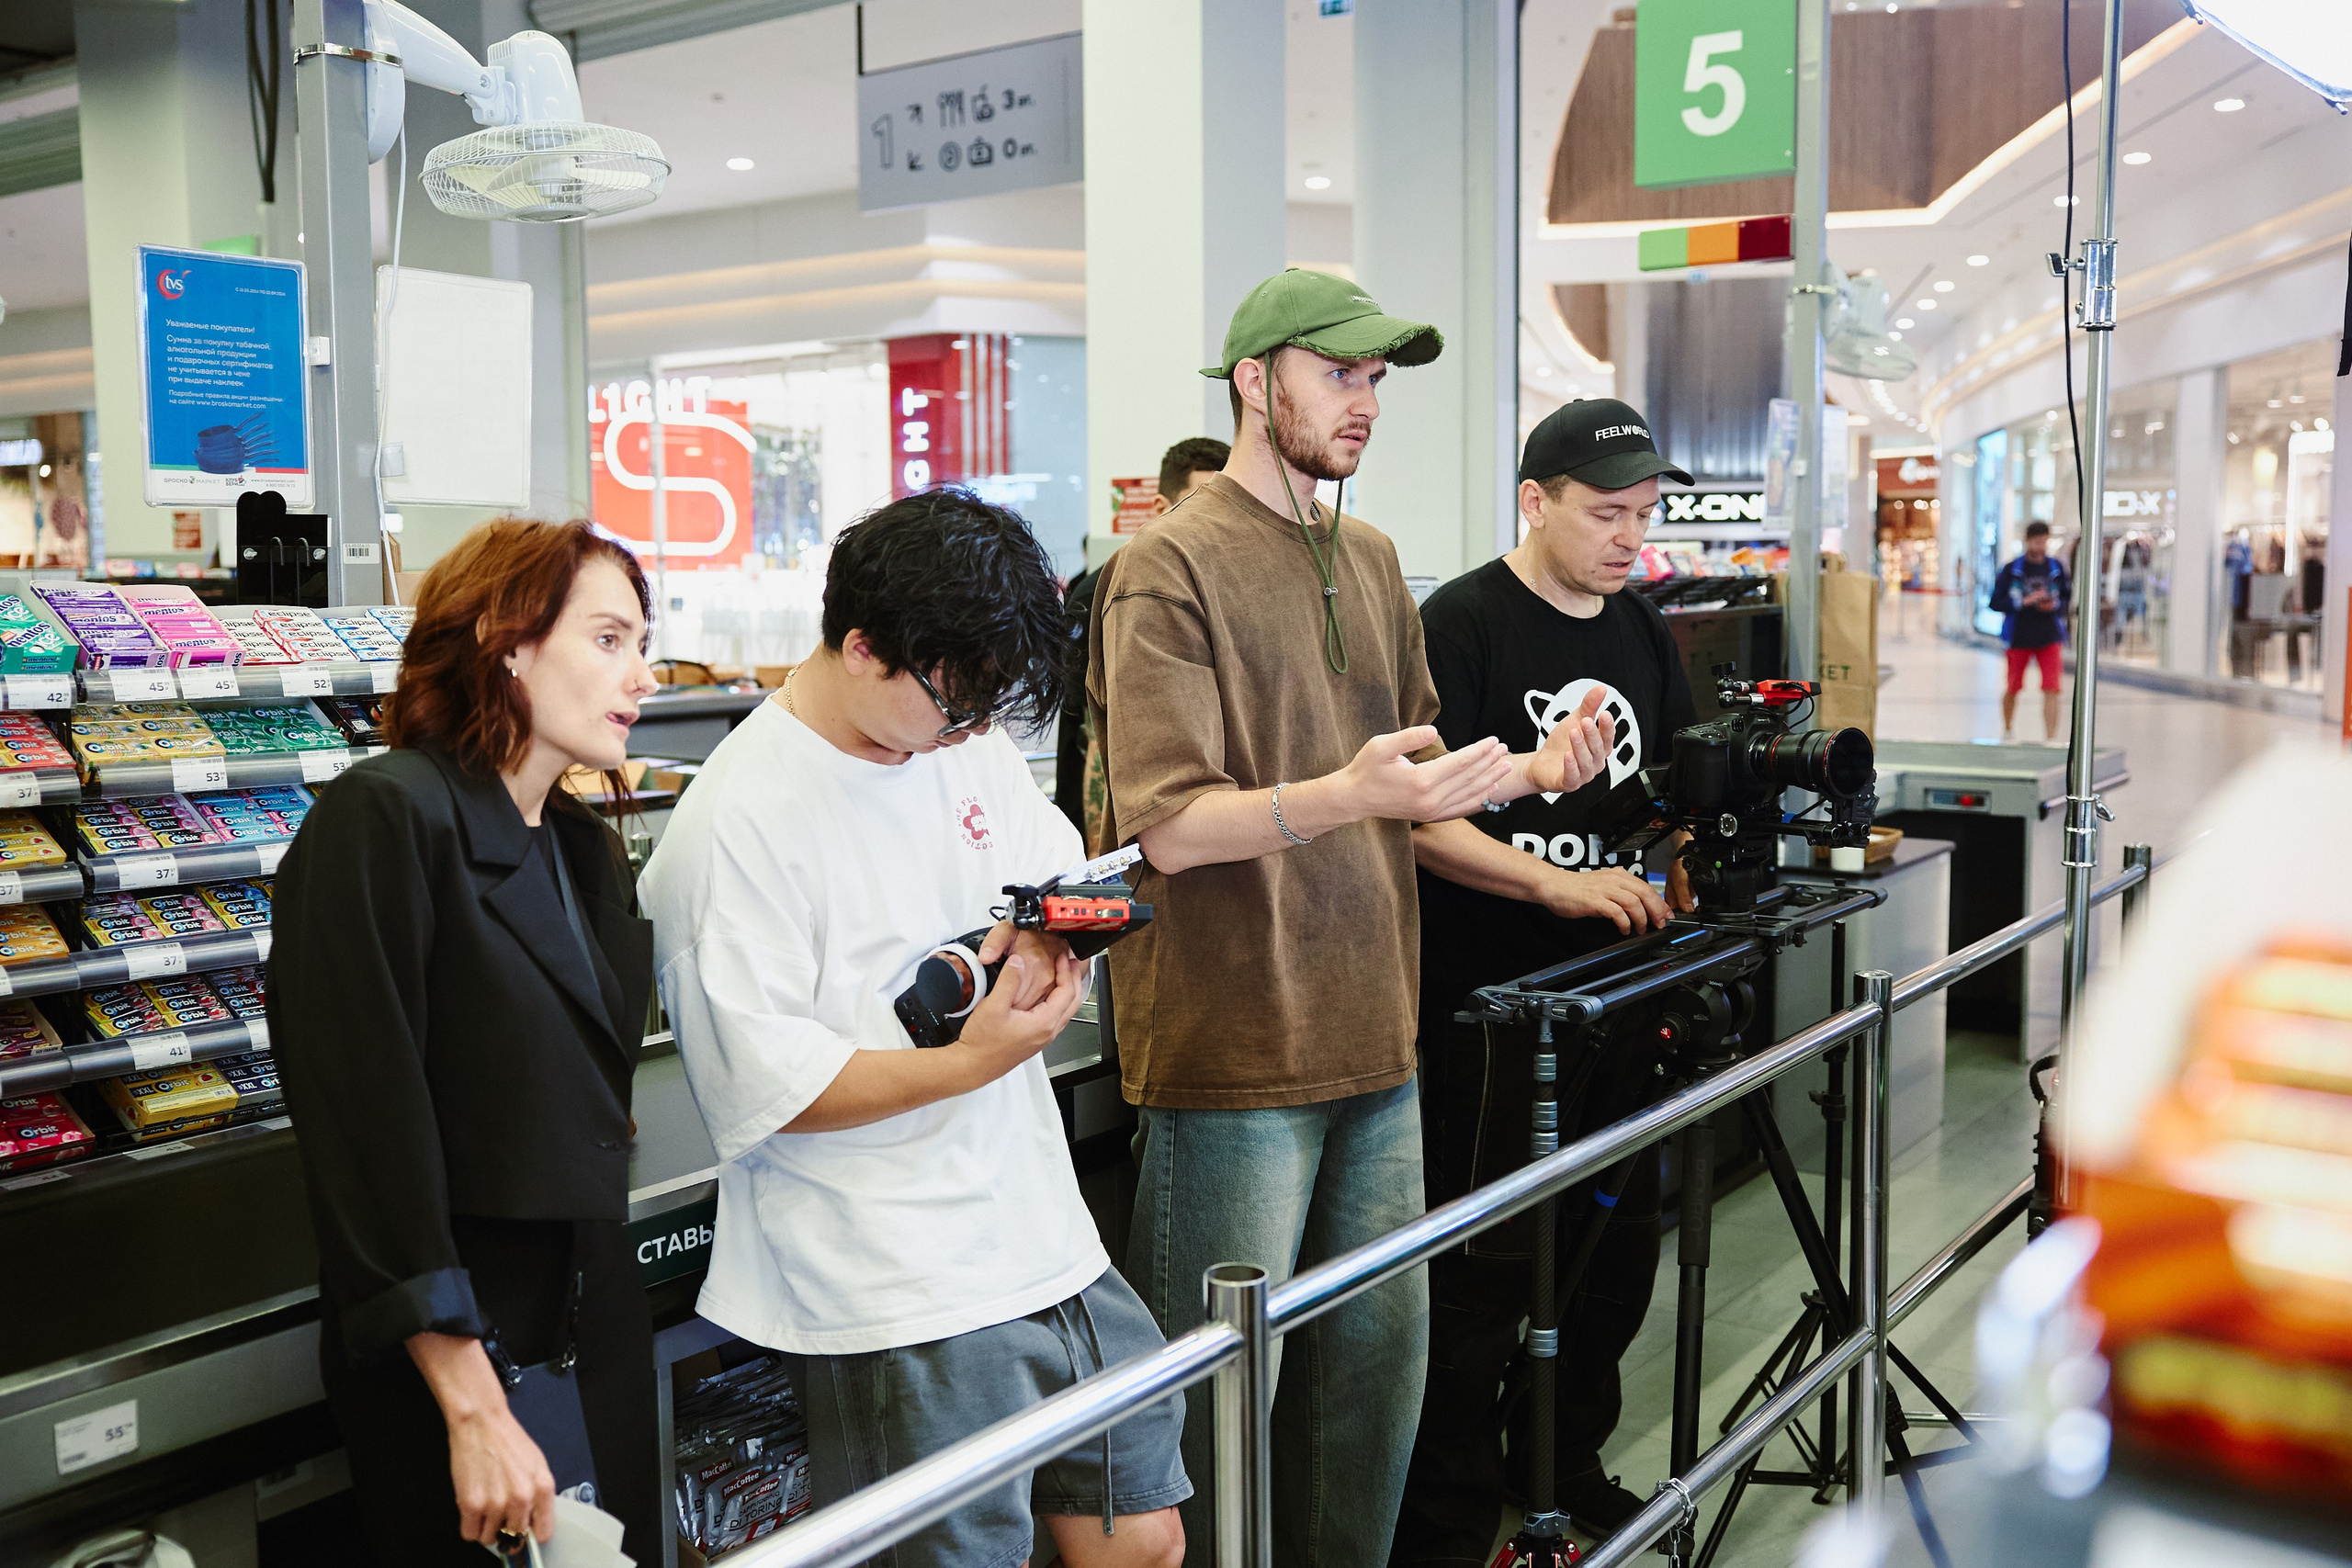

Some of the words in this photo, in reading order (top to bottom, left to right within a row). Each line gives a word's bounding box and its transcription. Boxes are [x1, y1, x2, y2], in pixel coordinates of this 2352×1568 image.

[1680, 29, 1746, 136] 5
[165, 275, 184, 290] tvs
[165, 319, 209, 330] Уважаемые
[210, 323, 255, 333] покупатели!
[166, 334, 192, 344] Сумма
[203, 339, 234, 348] покупку
[166, 346, 216, 355] алкогольной
[217, 350, 257, 358] продукции
[174, 356, 220, 366] подарочных
[221, 361, 274, 369] сертификатов
[178, 367, 226, 376] учитывается
[184, 377, 211, 385] выдаче
[168, 389, 204, 398] Подробные
[1595, 424, 1650, 441] FEELWORLD
[901, 388, 931, 490] GHT
[144, 606, 185, 615] mentos
[267, 610, 312, 618] eclipse
[280, 621, 323, 630] eclipse
[337, 617, 382, 626] eclipse
[7, 621, 51, 647] mentos
[288, 630, 332, 638] eclipse
[346, 628, 390, 637] eclipse
[175, 638, 216, 647] mentos
[300, 640, 344, 649] eclipse
[307, 650, 351, 659] eclipse
[149, 682, 164, 692] 45
[215, 681, 231, 690] 45
[313, 680, 326, 689] 52
[47, 694, 62, 702] 42
[254, 708, 286, 717] Orbit
[75, 725, 110, 735] Orbit
[146, 721, 179, 731] Orbit
[288, 730, 317, 739] Orbit
[7, 740, 40, 750] Orbit
[88, 742, 125, 753] Orbit
[158, 738, 191, 749] Orbit
[17, 753, 50, 762] Orbit
[333, 762, 345, 772] 53
[206, 773, 220, 782] 53
[17, 788, 32, 798] 37
[258, 797, 285, 806] Orbit
[141, 808, 169, 818] Orbit
[213, 805, 241, 813] Orbit
[280, 809, 306, 818] Orbit
[87, 816, 118, 825] Orbit
[148, 820, 177, 829] Orbit
[224, 817, 252, 825] Orbit
[98, 827, 129, 835] Orbit
[232, 828, 260, 837] Orbit
[107, 839, 138, 849] Orbit
[170, 834, 200, 844] Orbit
[1, 849, 33, 859] Orbit
[155, 869, 169, 879] 37
[215, 890, 243, 900] Orbit
[152, 898, 182, 908] Orbit
[226, 904, 254, 913] Orbit
[162, 910, 192, 920] Orbit
[237, 915, 266, 924] Orbit
[100, 918, 130, 928] Orbit
[172, 921, 202, 931] Orbit
[110, 931, 141, 941] Orbit
[1, 944, 36, 956] Orbit
[164, 955, 177, 966] 37
[94, 988, 120, 1002] Orbit
[159, 986, 187, 997] Orbit
[219, 985, 249, 997] Orbit
[168, 998, 198, 1009] Orbit
[230, 997, 259, 1009] Orbit
[104, 1002, 130, 1016] Orbit
[178, 1010, 208, 1021] Orbit
[115, 1016, 142, 1030] Orbit
[169, 1047, 184, 1056] 41
[221, 1057, 237, 1066] XXL
[232, 1069, 248, 1077] XXL
[251, 1063, 277, 1074] Orbi
[137, 1087, 154, 1096] XXL
[158, 1079, 190, 1090] Orbit
[242, 1082, 258, 1090] XXL
[20, 1125, 59, 1138] Orbit
[637, 1220, 717, 1264] СТАВЬ
[723, 1471, 760, 1495] MacCoffee
[729, 1519, 742, 1529] DI
[745, 1496, 783, 1521] TORINO
